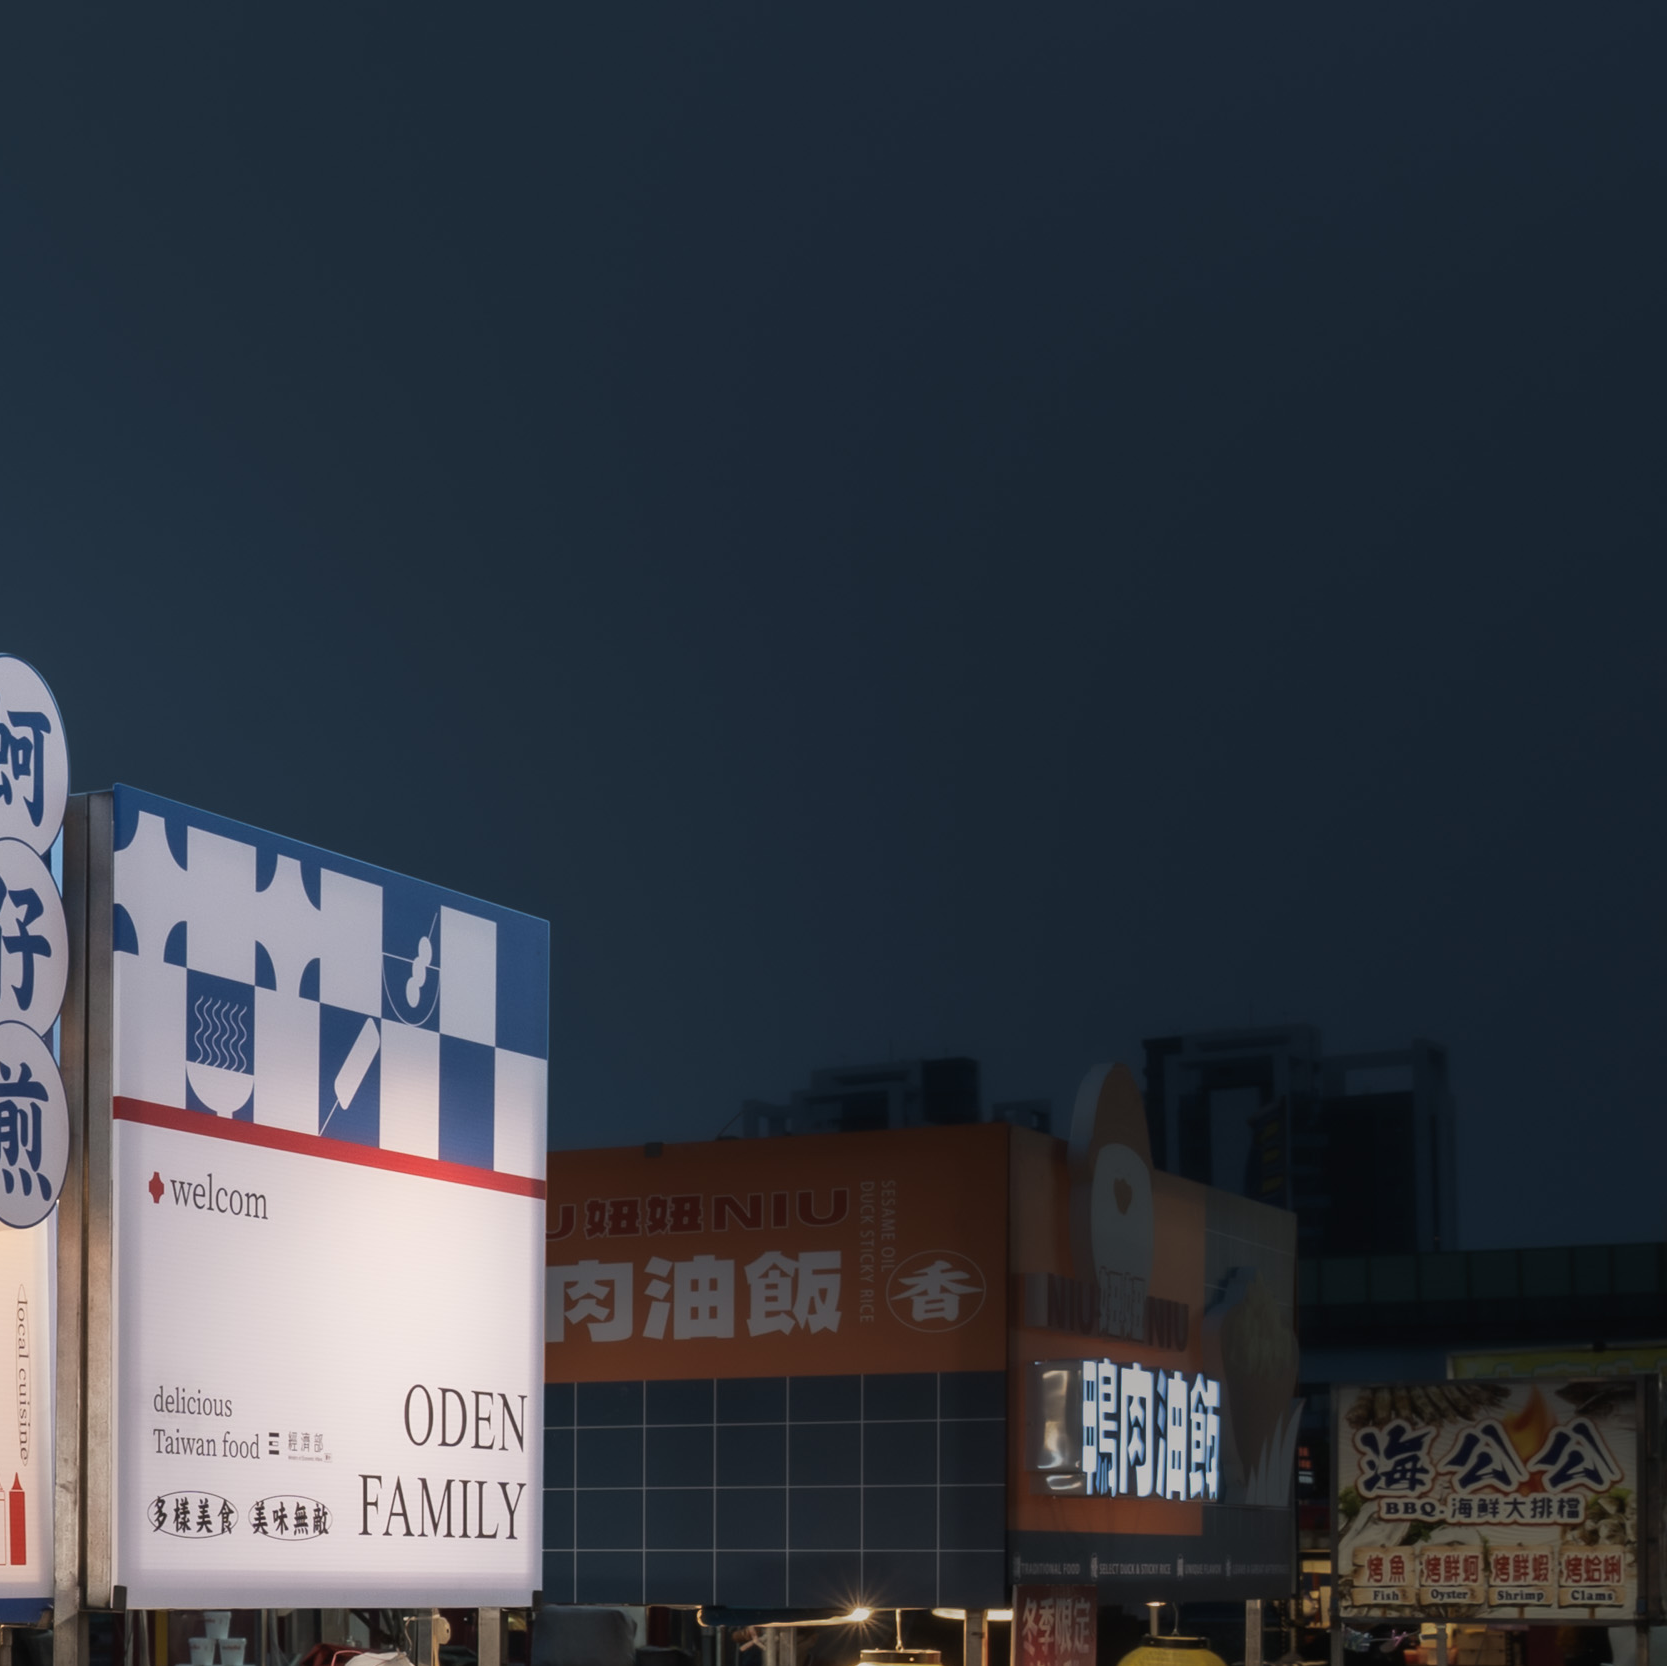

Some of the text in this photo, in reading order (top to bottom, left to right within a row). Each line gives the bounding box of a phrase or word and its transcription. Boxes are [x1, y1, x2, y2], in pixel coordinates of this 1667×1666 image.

[169, 1173, 269, 1220] welcom
[880, 1179, 897, 1273] SESAME OIL
[859, 1181, 875, 1324] DUCK STICKY RICE
[889, 1260, 985, 1323] 香
[16, 1299, 30, 1462] local cuisine
[153, 1385, 233, 1418] delicious
[403, 1383, 528, 1454] ODEN
[152, 1428, 261, 1460] Taiwan food
[1082, 1358, 1221, 1501] 鴨肉油飯
[1360, 1422, 1618, 1493] 海公公
[152, 1495, 330, 1536] 多樣美食 美味無敵
[357, 1473, 527, 1541] FAMILY
[1063, 1563, 1080, 1575] FOOD
[1366, 1554, 1406, 1584] 烤魚
[1423, 1554, 1480, 1584] 烤鮮蚵
[1492, 1553, 1550, 1583] 烤鮮蝦
[1564, 1554, 1622, 1584] 烤蛤蜊
[1372, 1588, 1400, 1601] Fish
[1430, 1588, 1469, 1601] Oyster
[1497, 1588, 1545, 1603] Shrimp
[1571, 1589, 1613, 1601] Clams
[1022, 1597, 1092, 1656] 冬季限定
